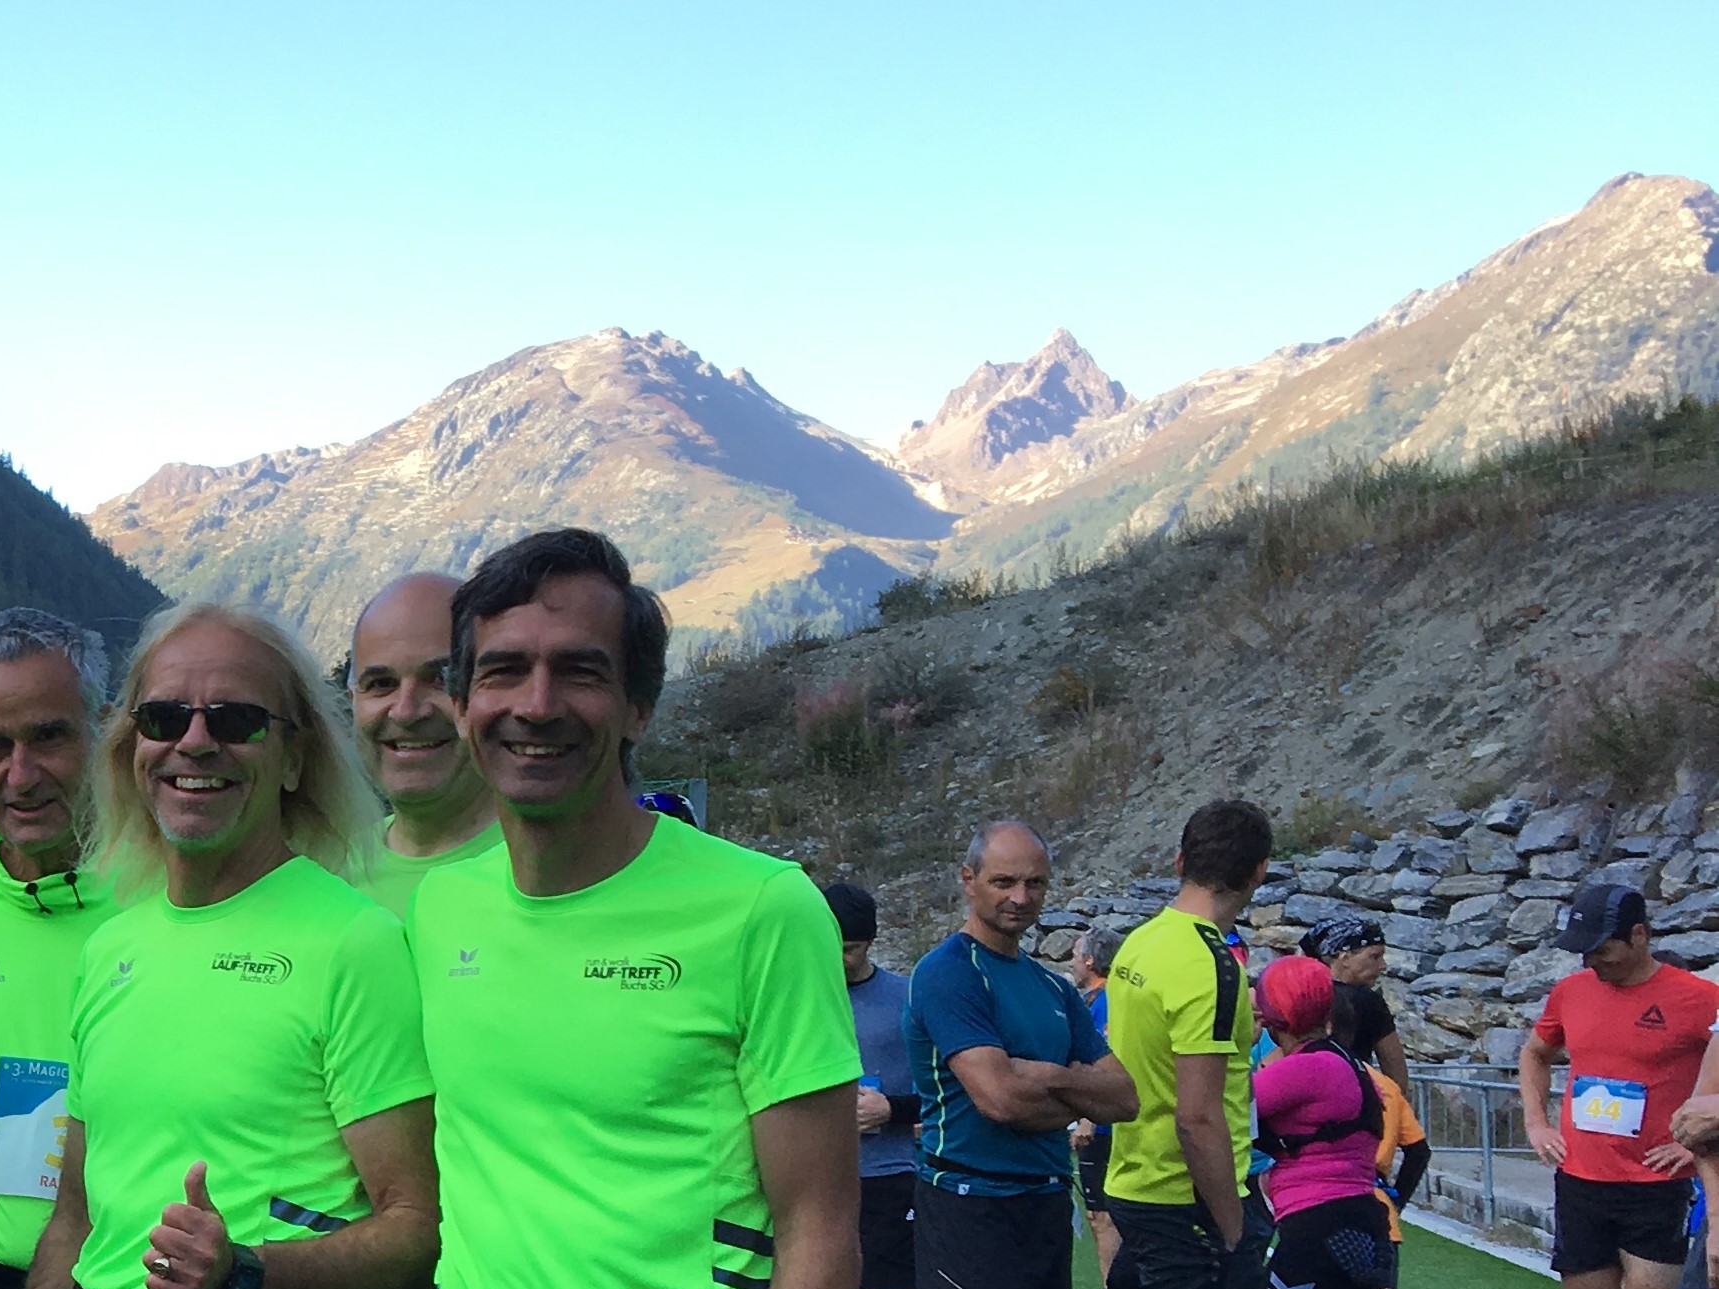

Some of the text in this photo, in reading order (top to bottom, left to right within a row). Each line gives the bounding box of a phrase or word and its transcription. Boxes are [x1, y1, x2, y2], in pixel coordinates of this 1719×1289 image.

[212, 959, 278, 975] LAUF-TREFF
[584, 966, 663, 980] LAUF-TREFF
[28, 1061, 69, 1079] MAGIC
[1585, 1098, 1622, 1121] 44
